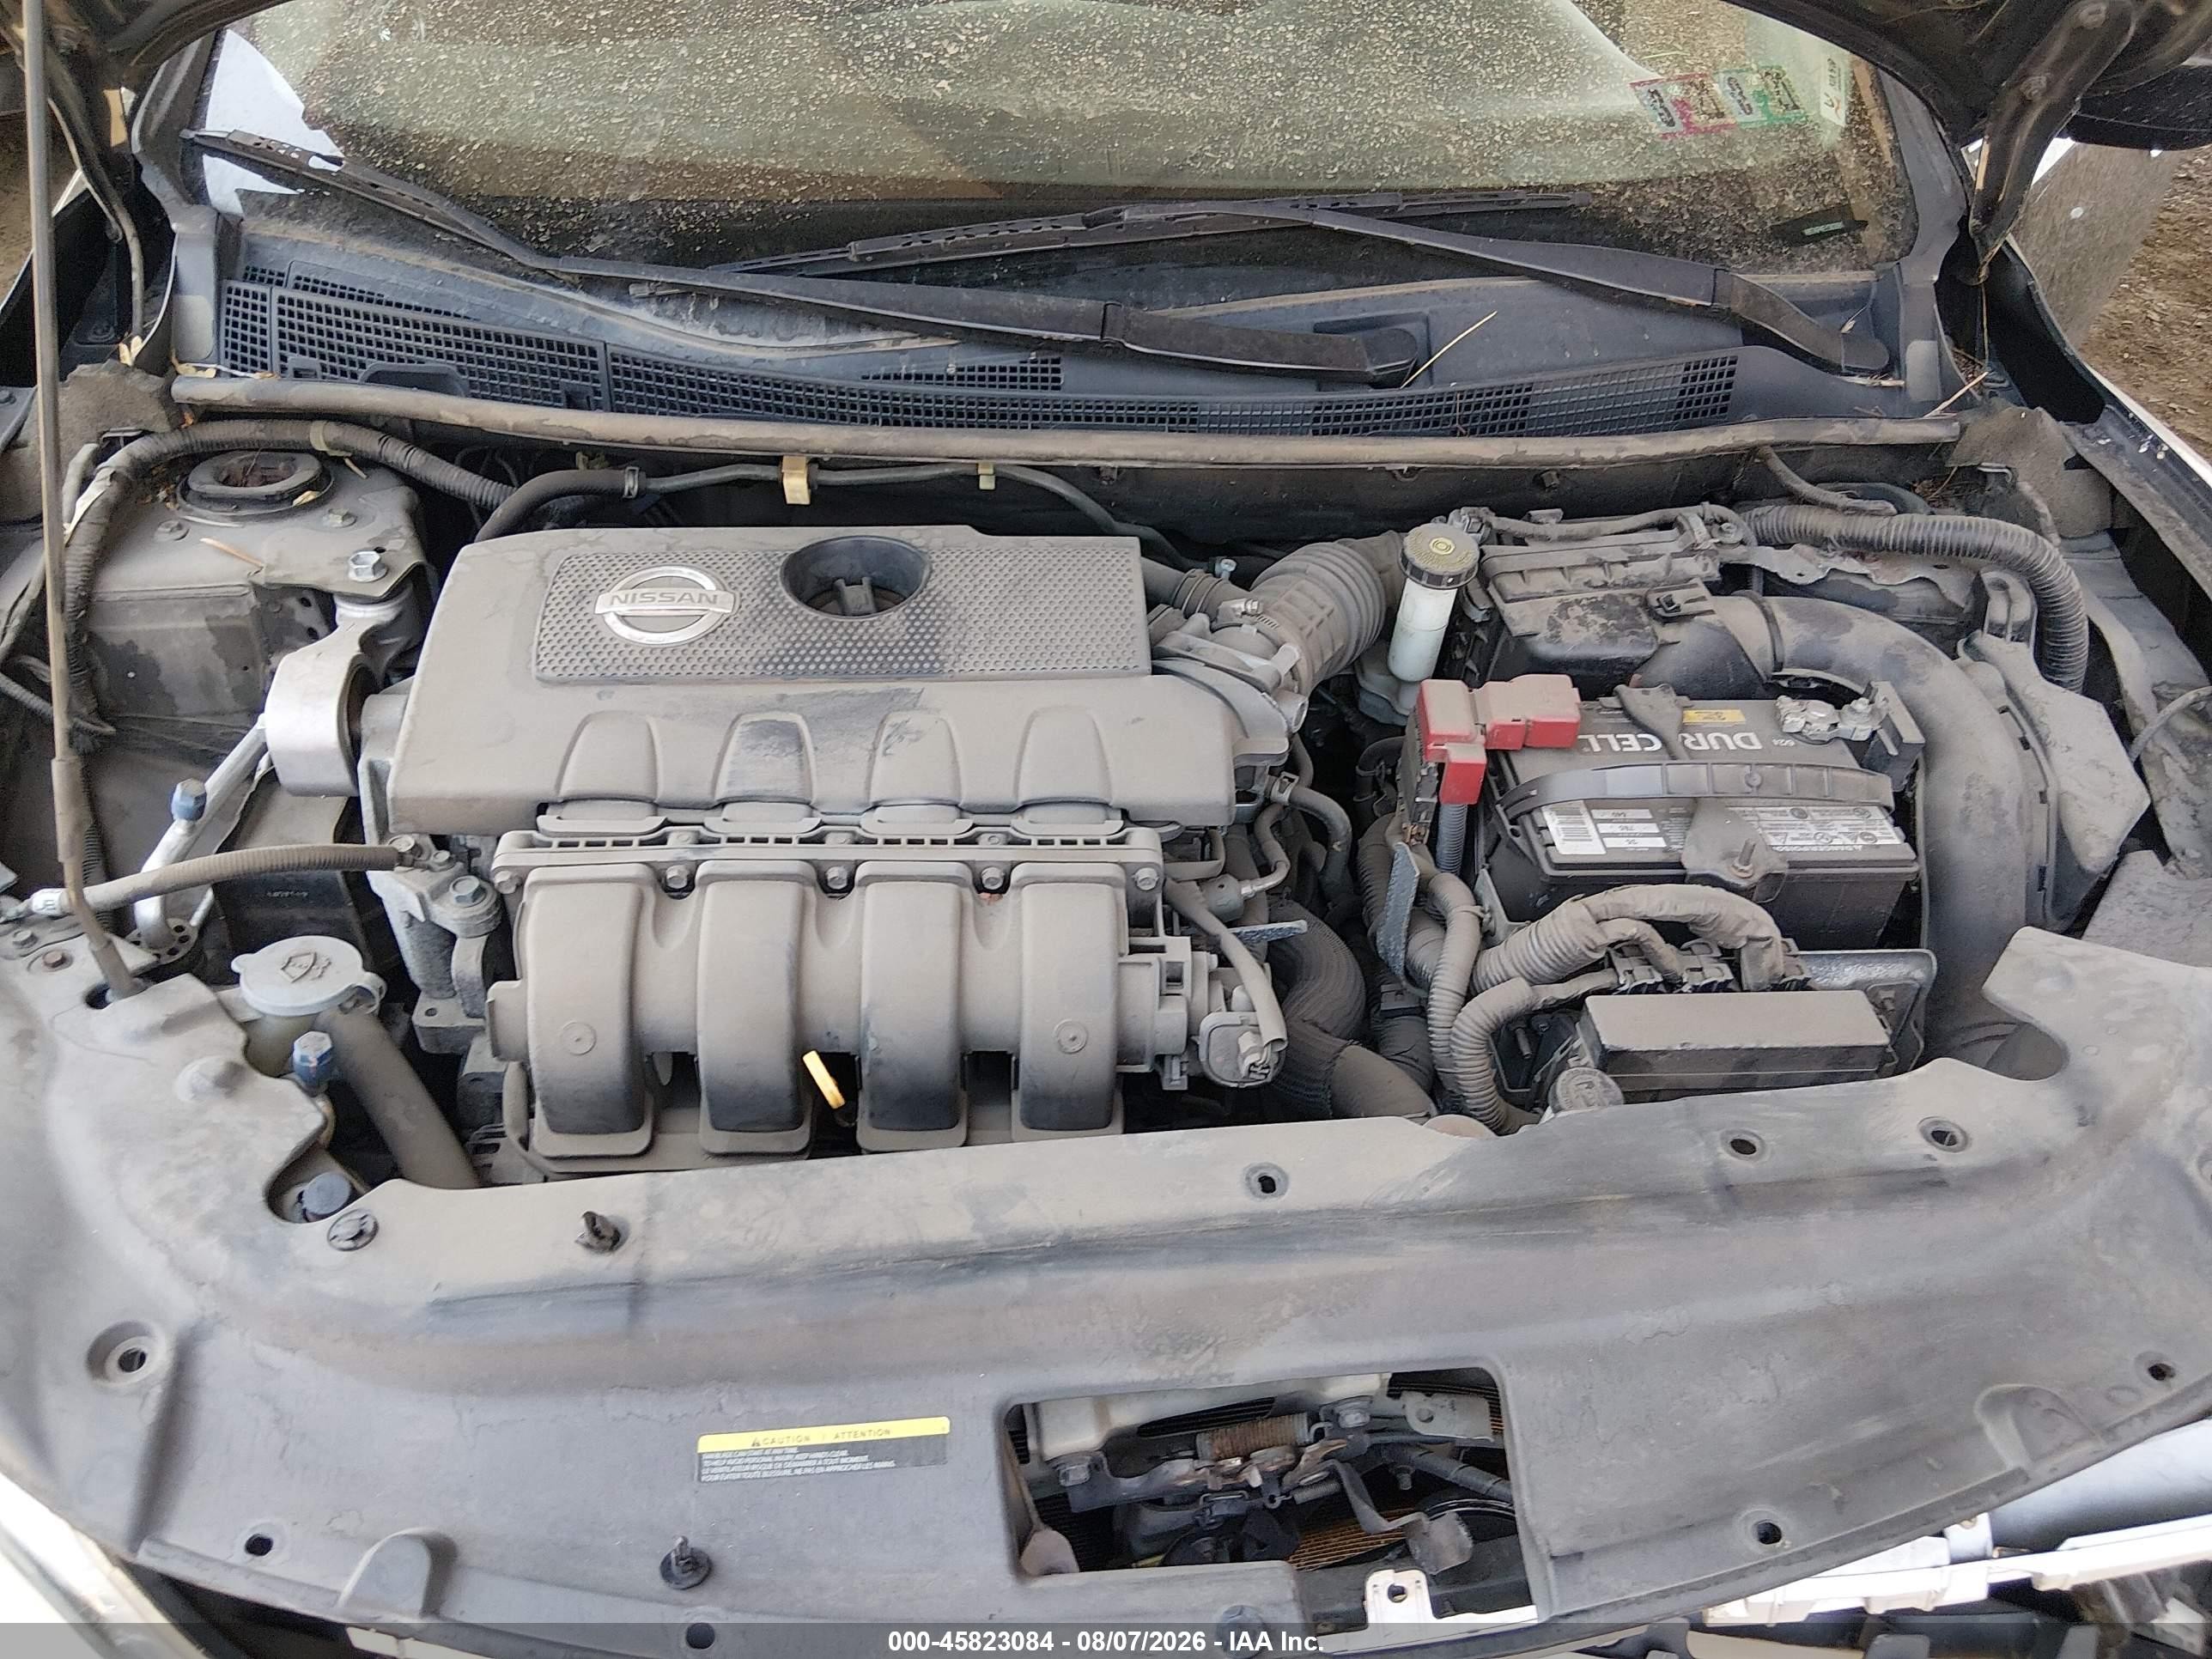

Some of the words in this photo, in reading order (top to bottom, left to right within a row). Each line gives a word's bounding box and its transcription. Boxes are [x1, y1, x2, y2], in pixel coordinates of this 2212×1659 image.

[610, 592, 718, 605] NISSAN
[1577, 732, 1763, 752] DURCELL
[762, 1435, 811, 1445] CAUTION
[834, 1428, 891, 1440] ATTENTION
